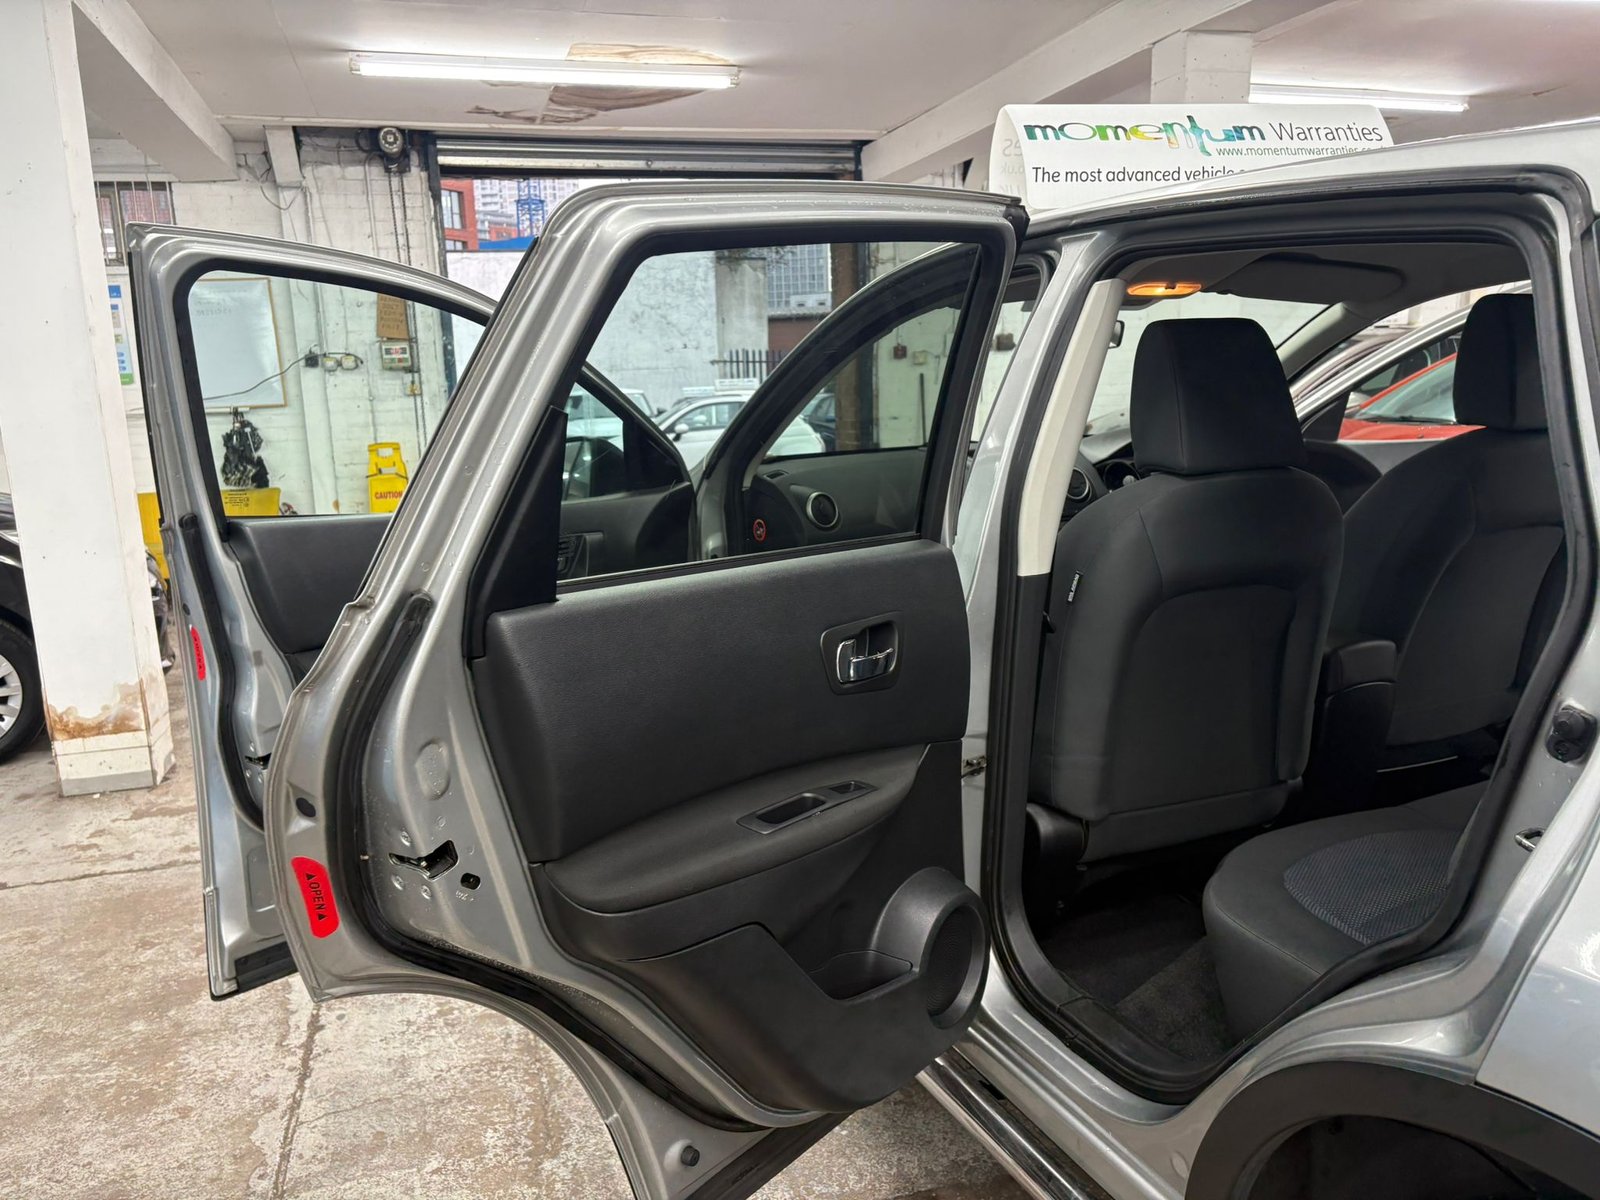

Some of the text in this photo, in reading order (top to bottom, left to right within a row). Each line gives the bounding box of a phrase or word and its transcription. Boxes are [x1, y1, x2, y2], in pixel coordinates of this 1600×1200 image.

[1023, 115, 1266, 157] momentum
[1269, 122, 1383, 142] Warranties
[1032, 167, 1060, 183] The
[1065, 168, 1102, 182] most
[1106, 166, 1180, 182] advanced
[308, 882, 326, 910] OPEN
